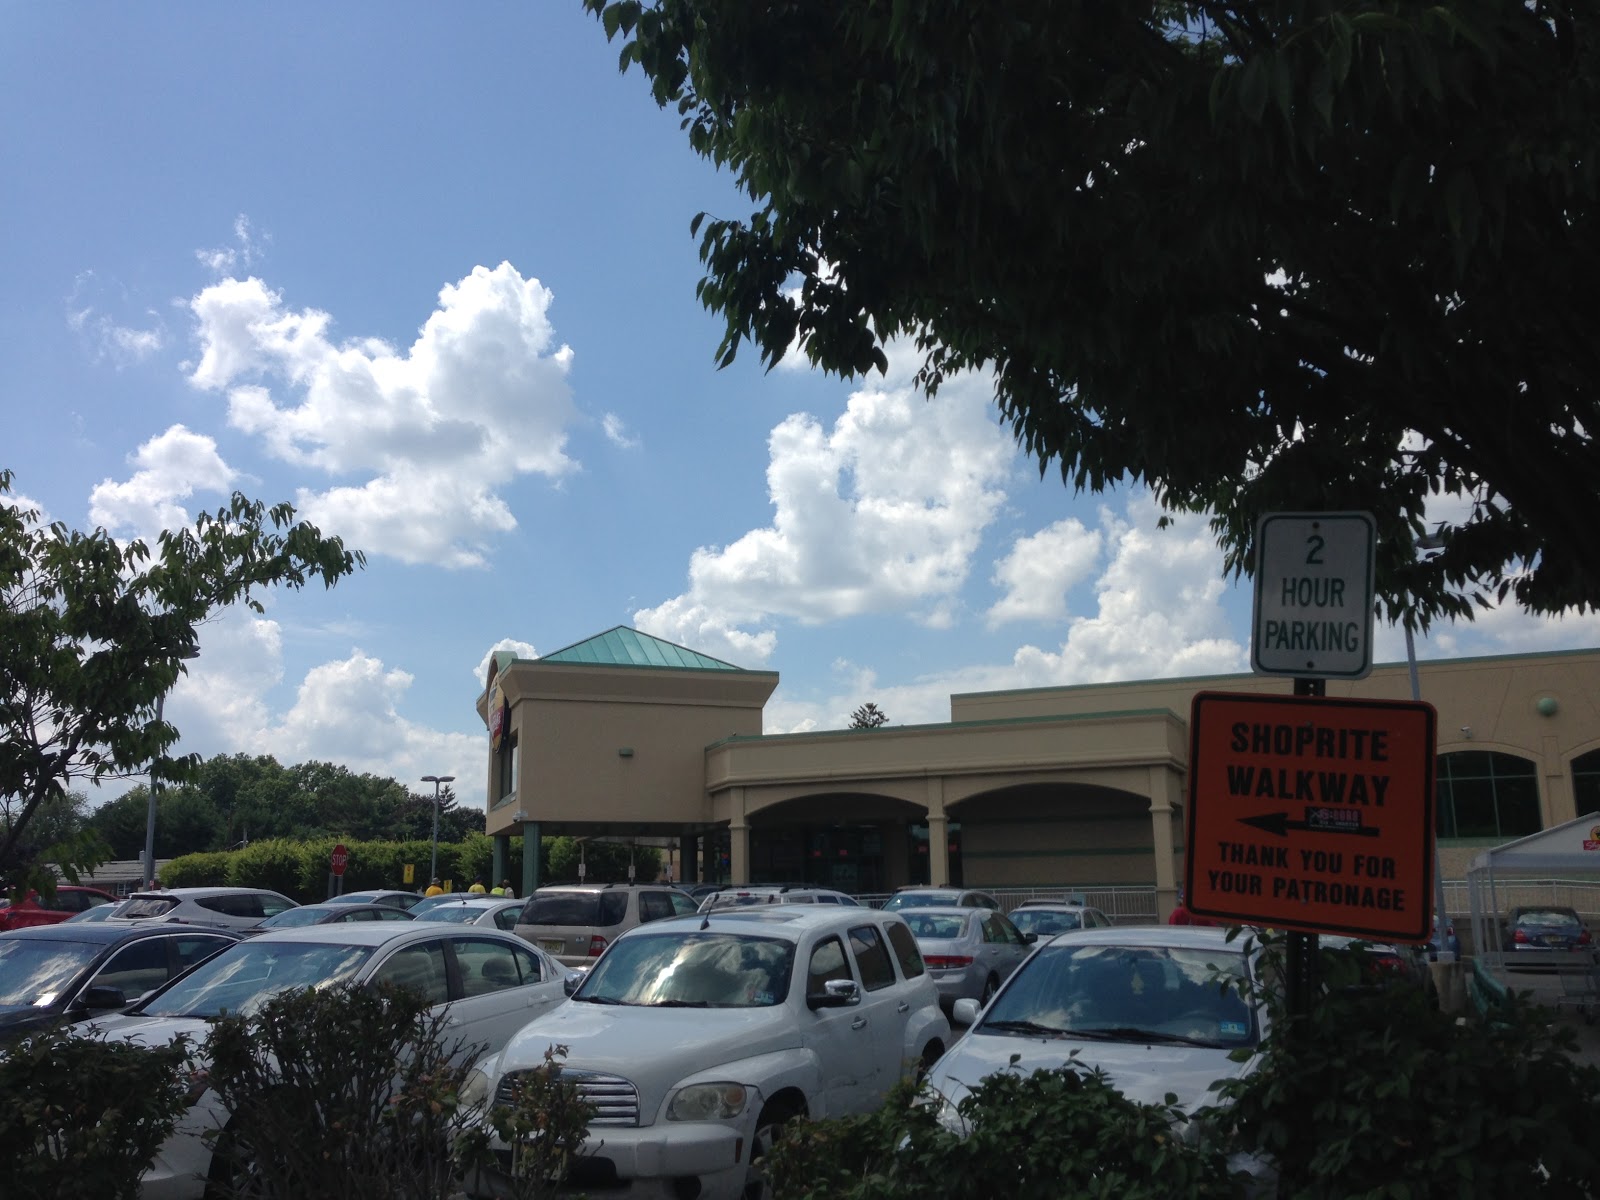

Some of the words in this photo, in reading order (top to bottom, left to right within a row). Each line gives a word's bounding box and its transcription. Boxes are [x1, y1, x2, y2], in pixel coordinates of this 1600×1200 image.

[1306, 535, 1325, 565] 2
[1281, 577, 1345, 608] HOUR
[1264, 620, 1359, 653] PARKING
[1231, 722, 1389, 762] SHOPRITE
[1227, 765, 1390, 807] WALKWAY
[332, 854, 347, 866] STOP
[1218, 841, 1289, 869] THANK
[1300, 849, 1343, 874] YOU
[1354, 855, 1396, 880] FOR
[1208, 870, 1262, 896] YOUR
[1273, 876, 1405, 912] PATRONAGE
